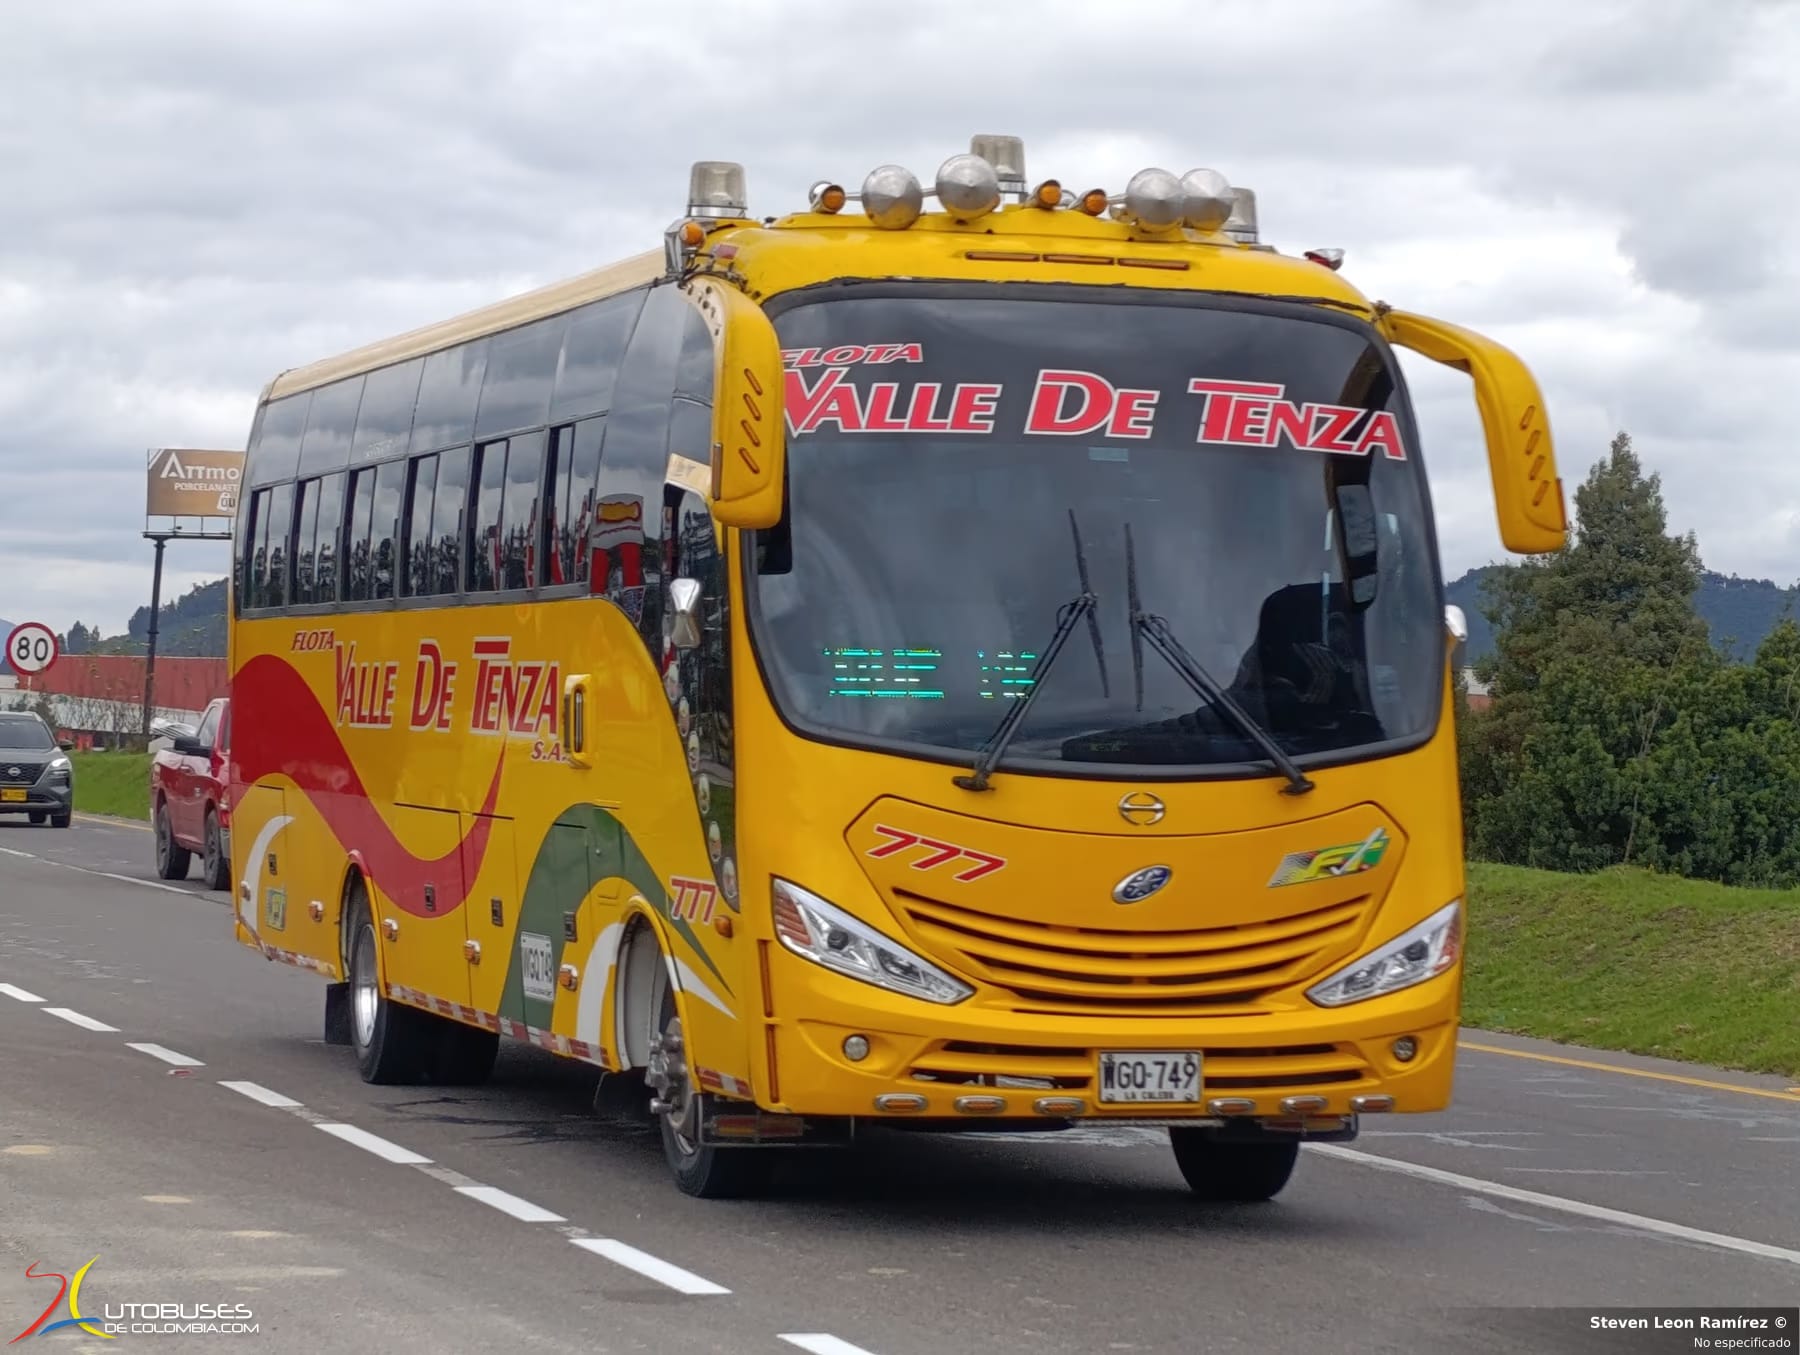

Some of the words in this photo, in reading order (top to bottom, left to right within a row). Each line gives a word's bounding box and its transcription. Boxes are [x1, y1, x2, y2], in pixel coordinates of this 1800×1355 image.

[783, 367, 1002, 438] VALLE
[1024, 369, 1160, 438] DE
[1188, 378, 1407, 461] TENZA
[16, 636, 48, 661] 80
[291, 629, 335, 651] FLOTA
[335, 641, 399, 728] VALLE
[409, 638, 458, 733] DE
[469, 636, 559, 739] TENZA
[866, 824, 1007, 882] 777
[670, 875, 718, 926] 777
